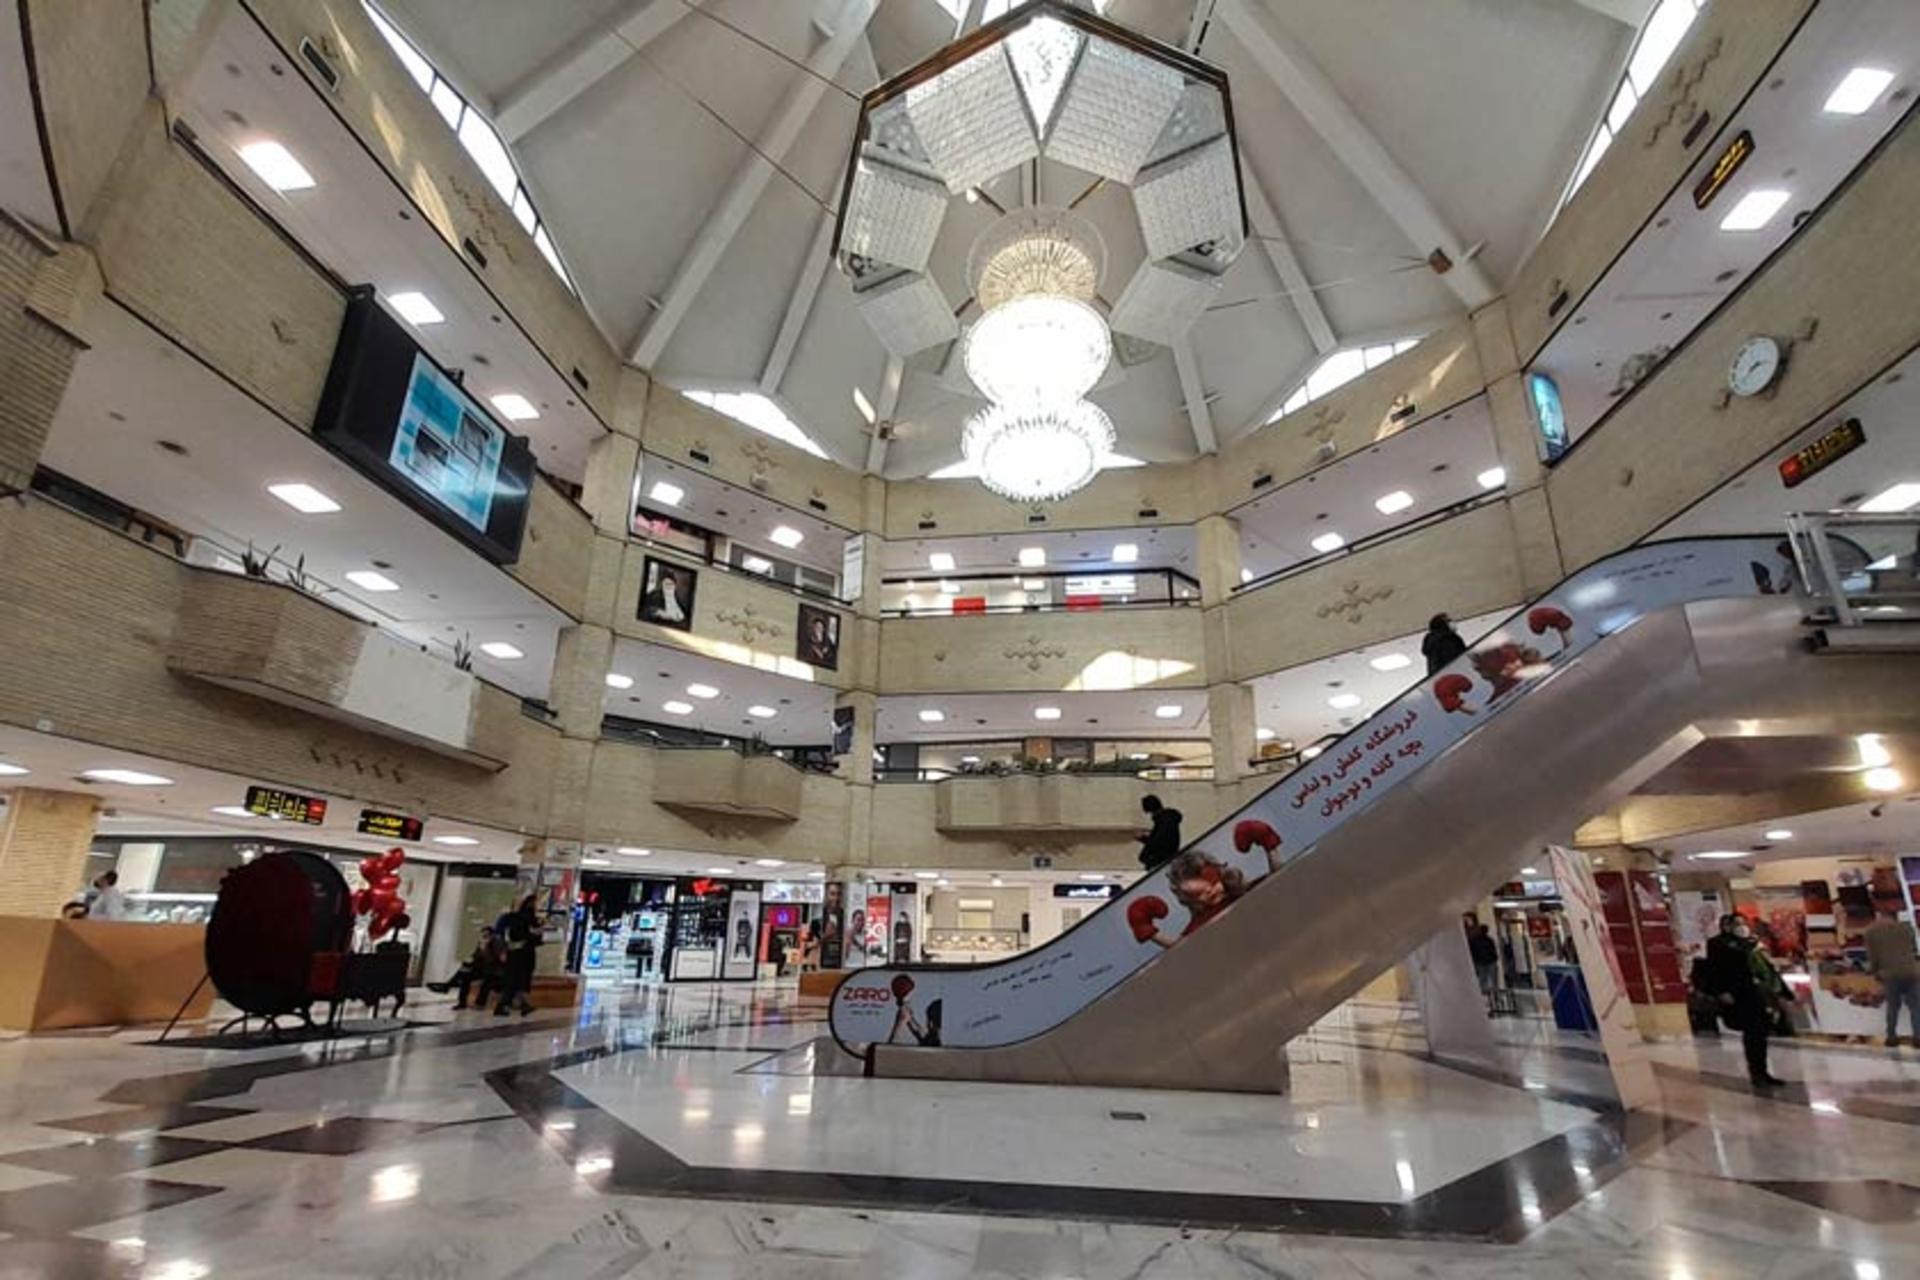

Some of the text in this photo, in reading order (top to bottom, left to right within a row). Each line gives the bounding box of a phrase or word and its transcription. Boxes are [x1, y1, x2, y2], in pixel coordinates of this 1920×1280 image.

[1398, 739, 1423, 756] بچه
[1291, 711, 1417, 809] فروشگاه کفش و لباس
[1361, 777, 1372, 789] و
[1321, 783, 1361, 817] نوجوان
[843, 987, 891, 1002] ZARO
